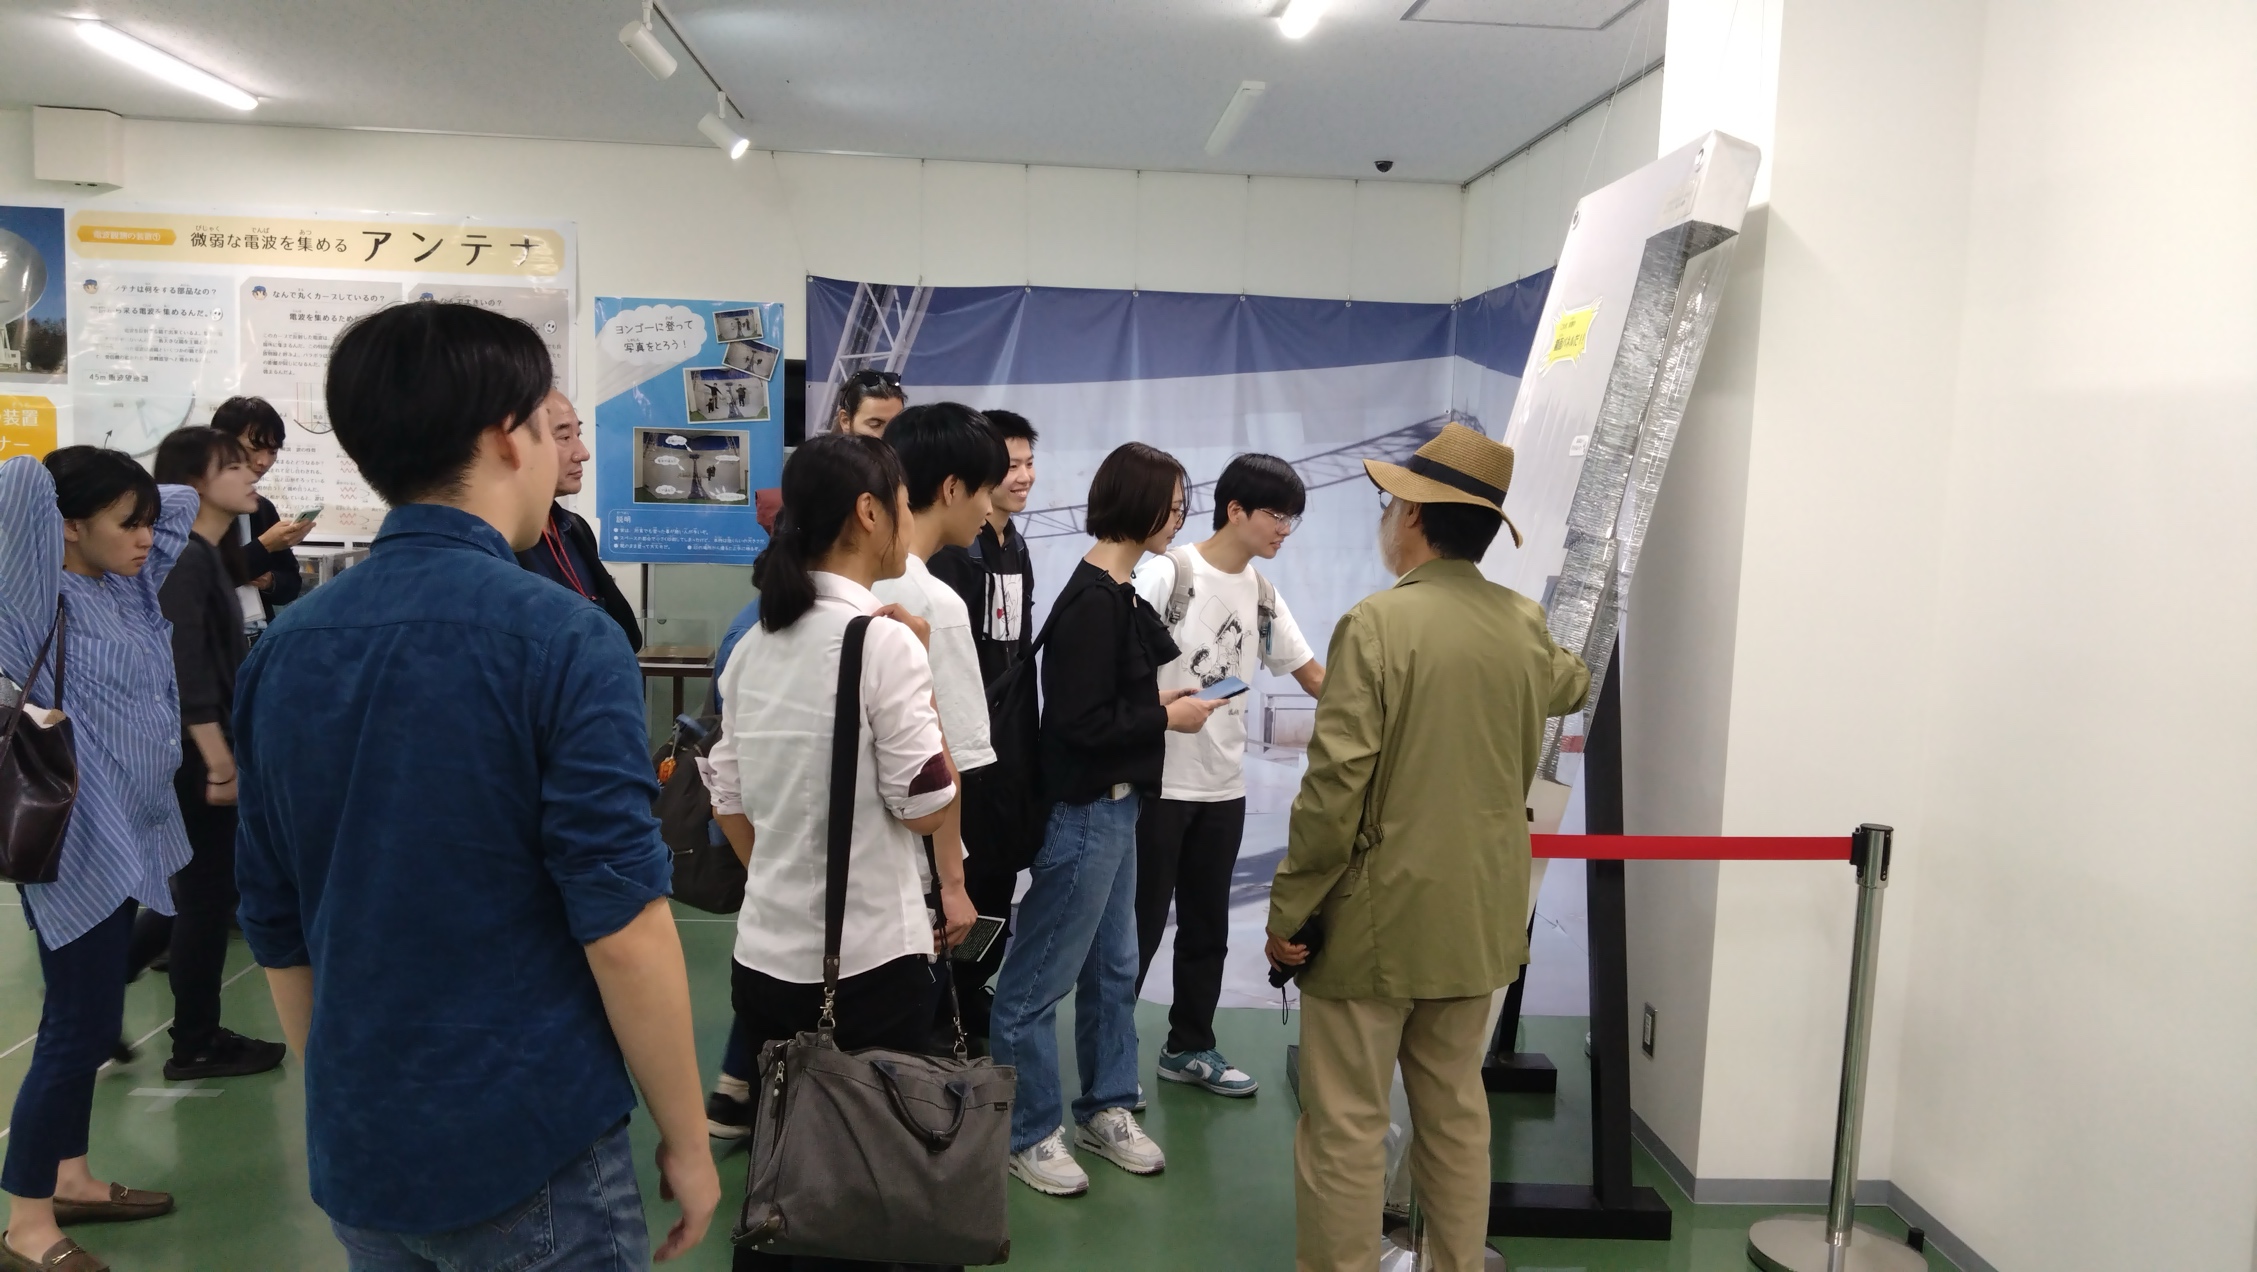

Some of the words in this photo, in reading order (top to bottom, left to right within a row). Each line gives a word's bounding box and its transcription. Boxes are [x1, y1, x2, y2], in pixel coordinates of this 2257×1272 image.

[190, 231, 348, 253] 微弱な電波を集める
[362, 231, 541, 267] アンテナ
[615, 320, 693, 335] ヨンゴーに登って
[0, 409, 39, 427] 装置
